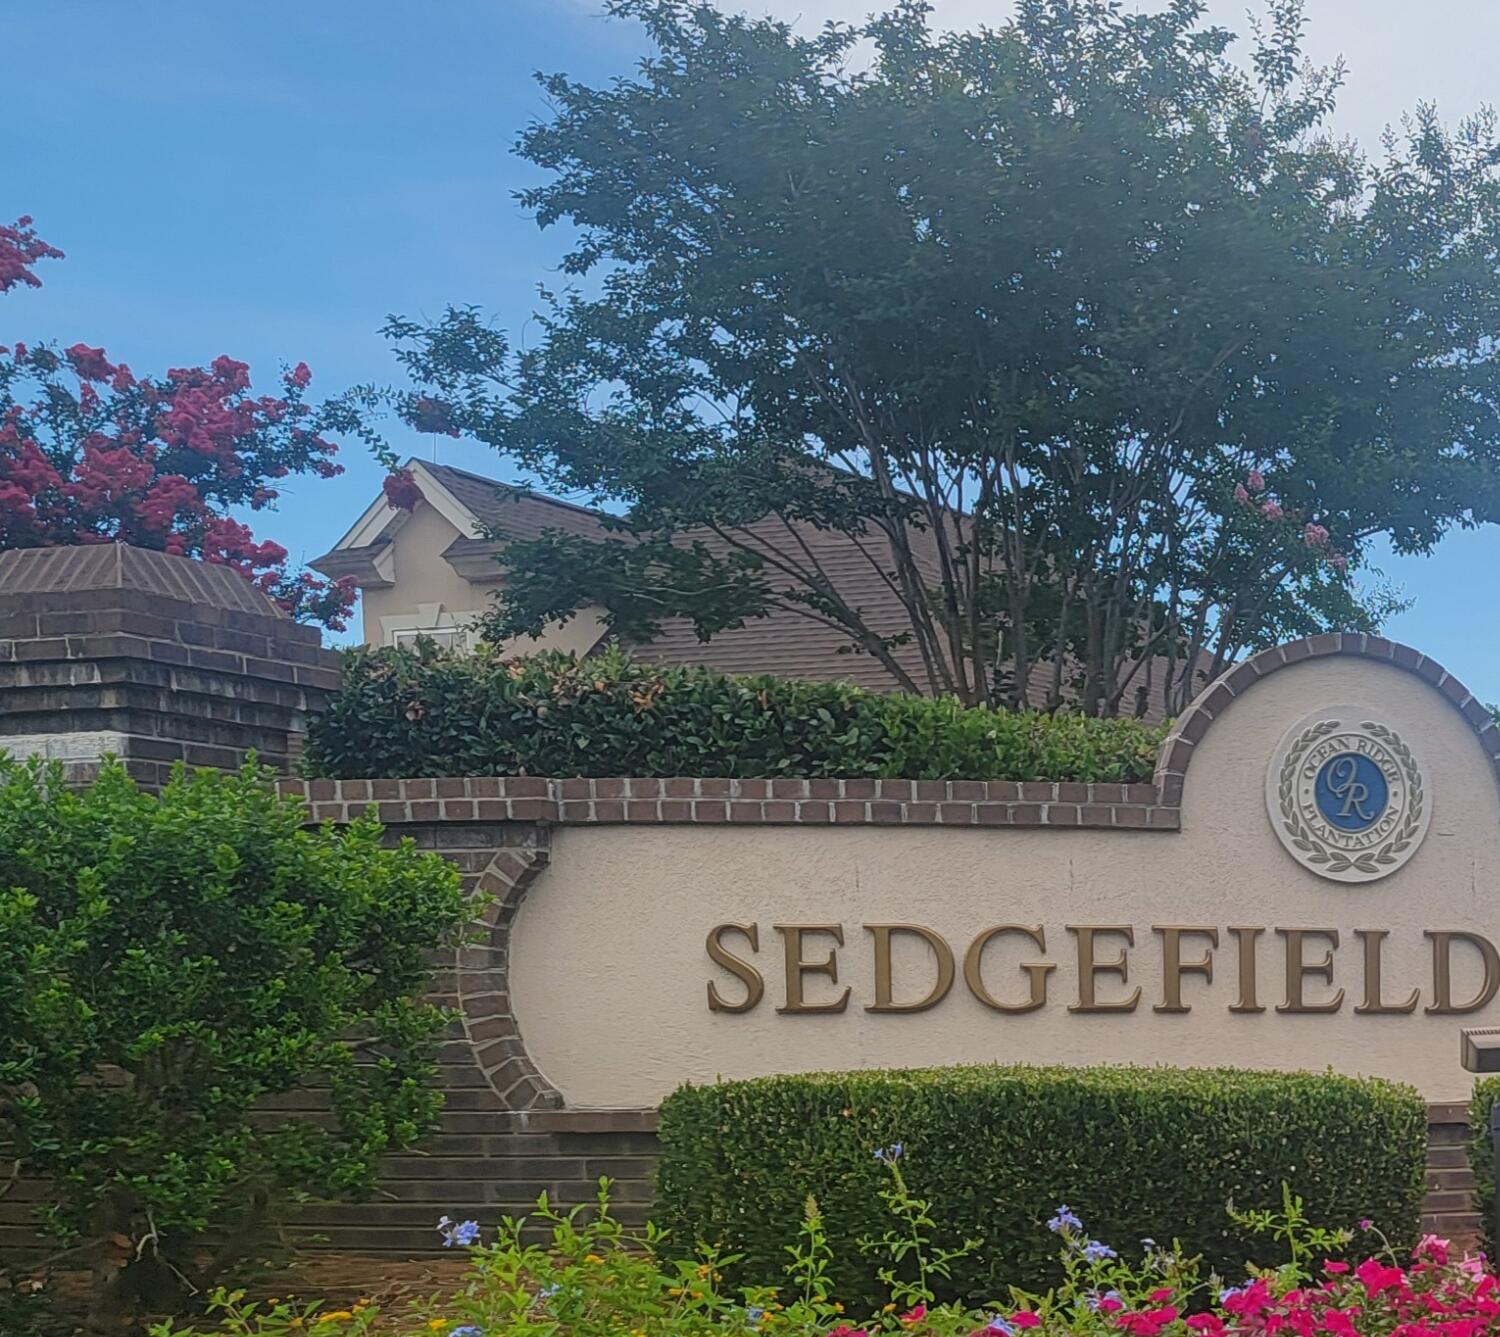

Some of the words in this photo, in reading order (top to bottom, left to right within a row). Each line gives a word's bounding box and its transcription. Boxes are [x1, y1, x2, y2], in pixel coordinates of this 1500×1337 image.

[1303, 737, 1350, 781] OCEAN
[1356, 738, 1401, 784] RIDGE
[1302, 802, 1400, 848] PLANTATION
